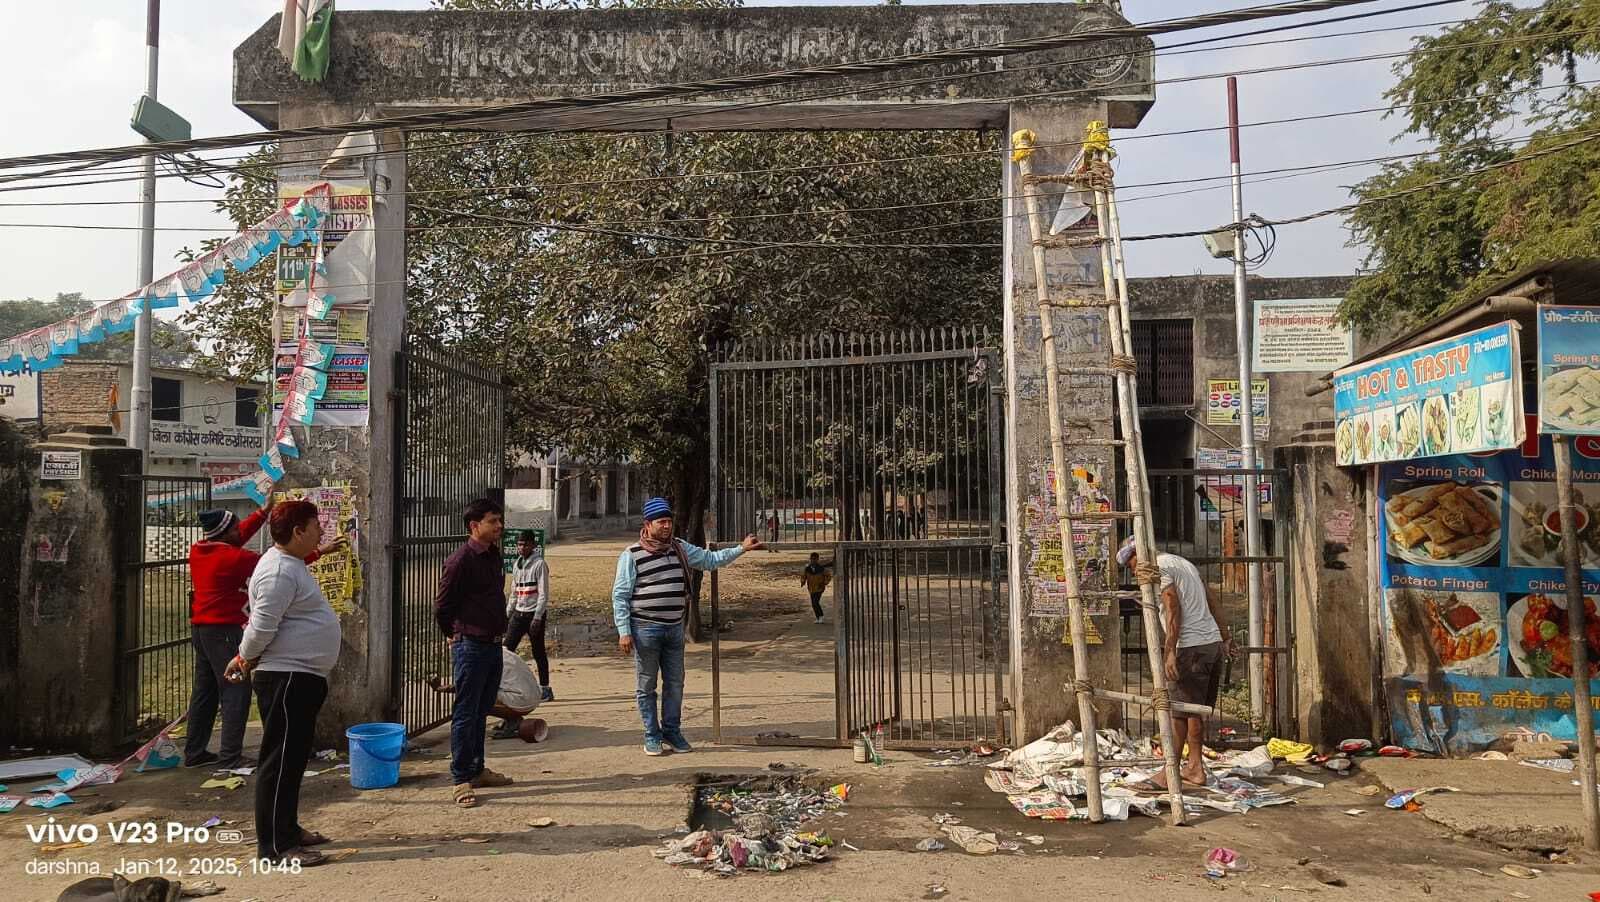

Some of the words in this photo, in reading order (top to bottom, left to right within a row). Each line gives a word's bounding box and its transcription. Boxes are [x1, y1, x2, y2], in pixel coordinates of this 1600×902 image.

[330, 196, 367, 209] LASSES
[282, 260, 304, 280] 11th
[1357, 370, 1392, 400] HOT
[1395, 367, 1409, 389] &
[1412, 343, 1470, 385] TASTY
[1405, 465, 1453, 479] Spring
[1457, 466, 1485, 477] Roll
[1391, 575, 1437, 587] Potato
[1442, 577, 1489, 591] Finger
[1528, 579, 1569, 591] Chike
